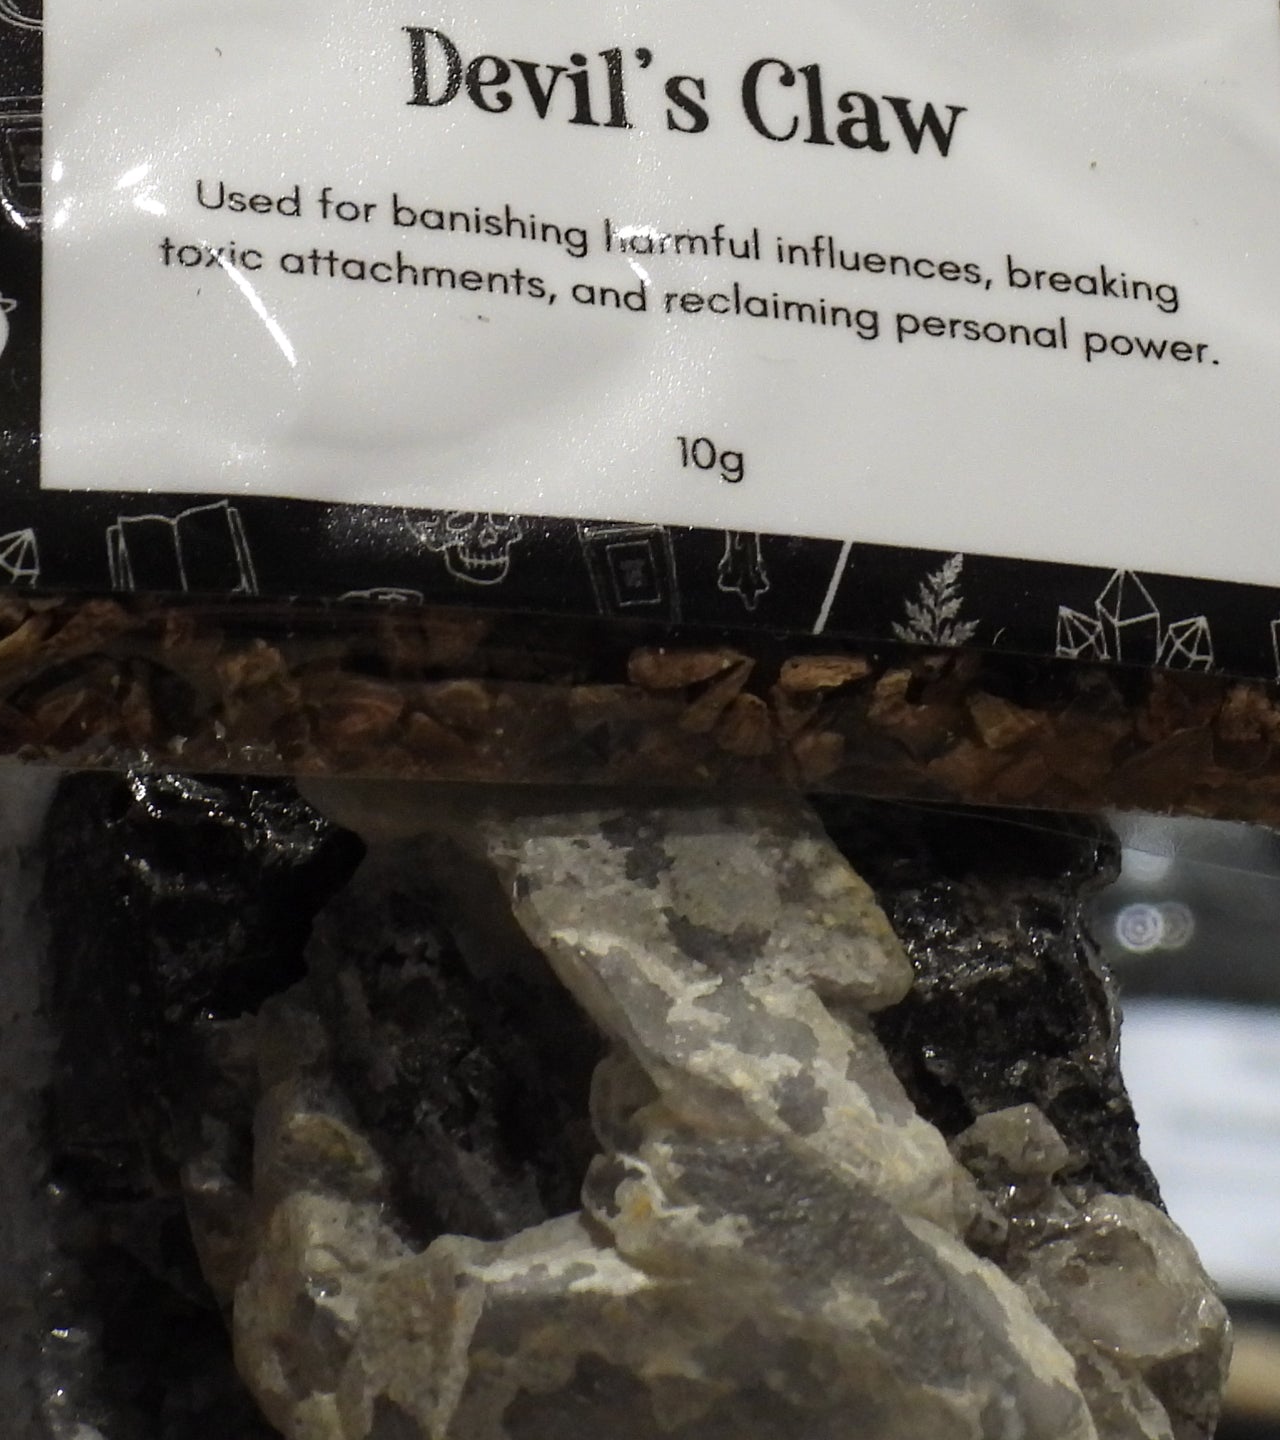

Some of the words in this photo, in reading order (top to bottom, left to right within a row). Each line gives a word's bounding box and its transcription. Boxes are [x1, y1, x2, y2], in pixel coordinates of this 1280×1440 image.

[406, 27, 709, 133] Devil's
[742, 58, 967, 157] Claw
[160, 237, 262, 270] toxic
[281, 249, 556, 305] attachments,
[572, 280, 646, 311] and
[665, 282, 879, 340] reclaiming
[896, 315, 1068, 350] personal
[1085, 332, 1219, 365] power.
[198, 180, 301, 216] Used
[319, 188, 376, 222] for
[393, 193, 587, 258] banishing
[604, 219, 760, 260] harmful
[777, 235, 991, 290] influences,
[1007, 255, 1178, 313] breaking
[677, 437, 744, 483] 10g
